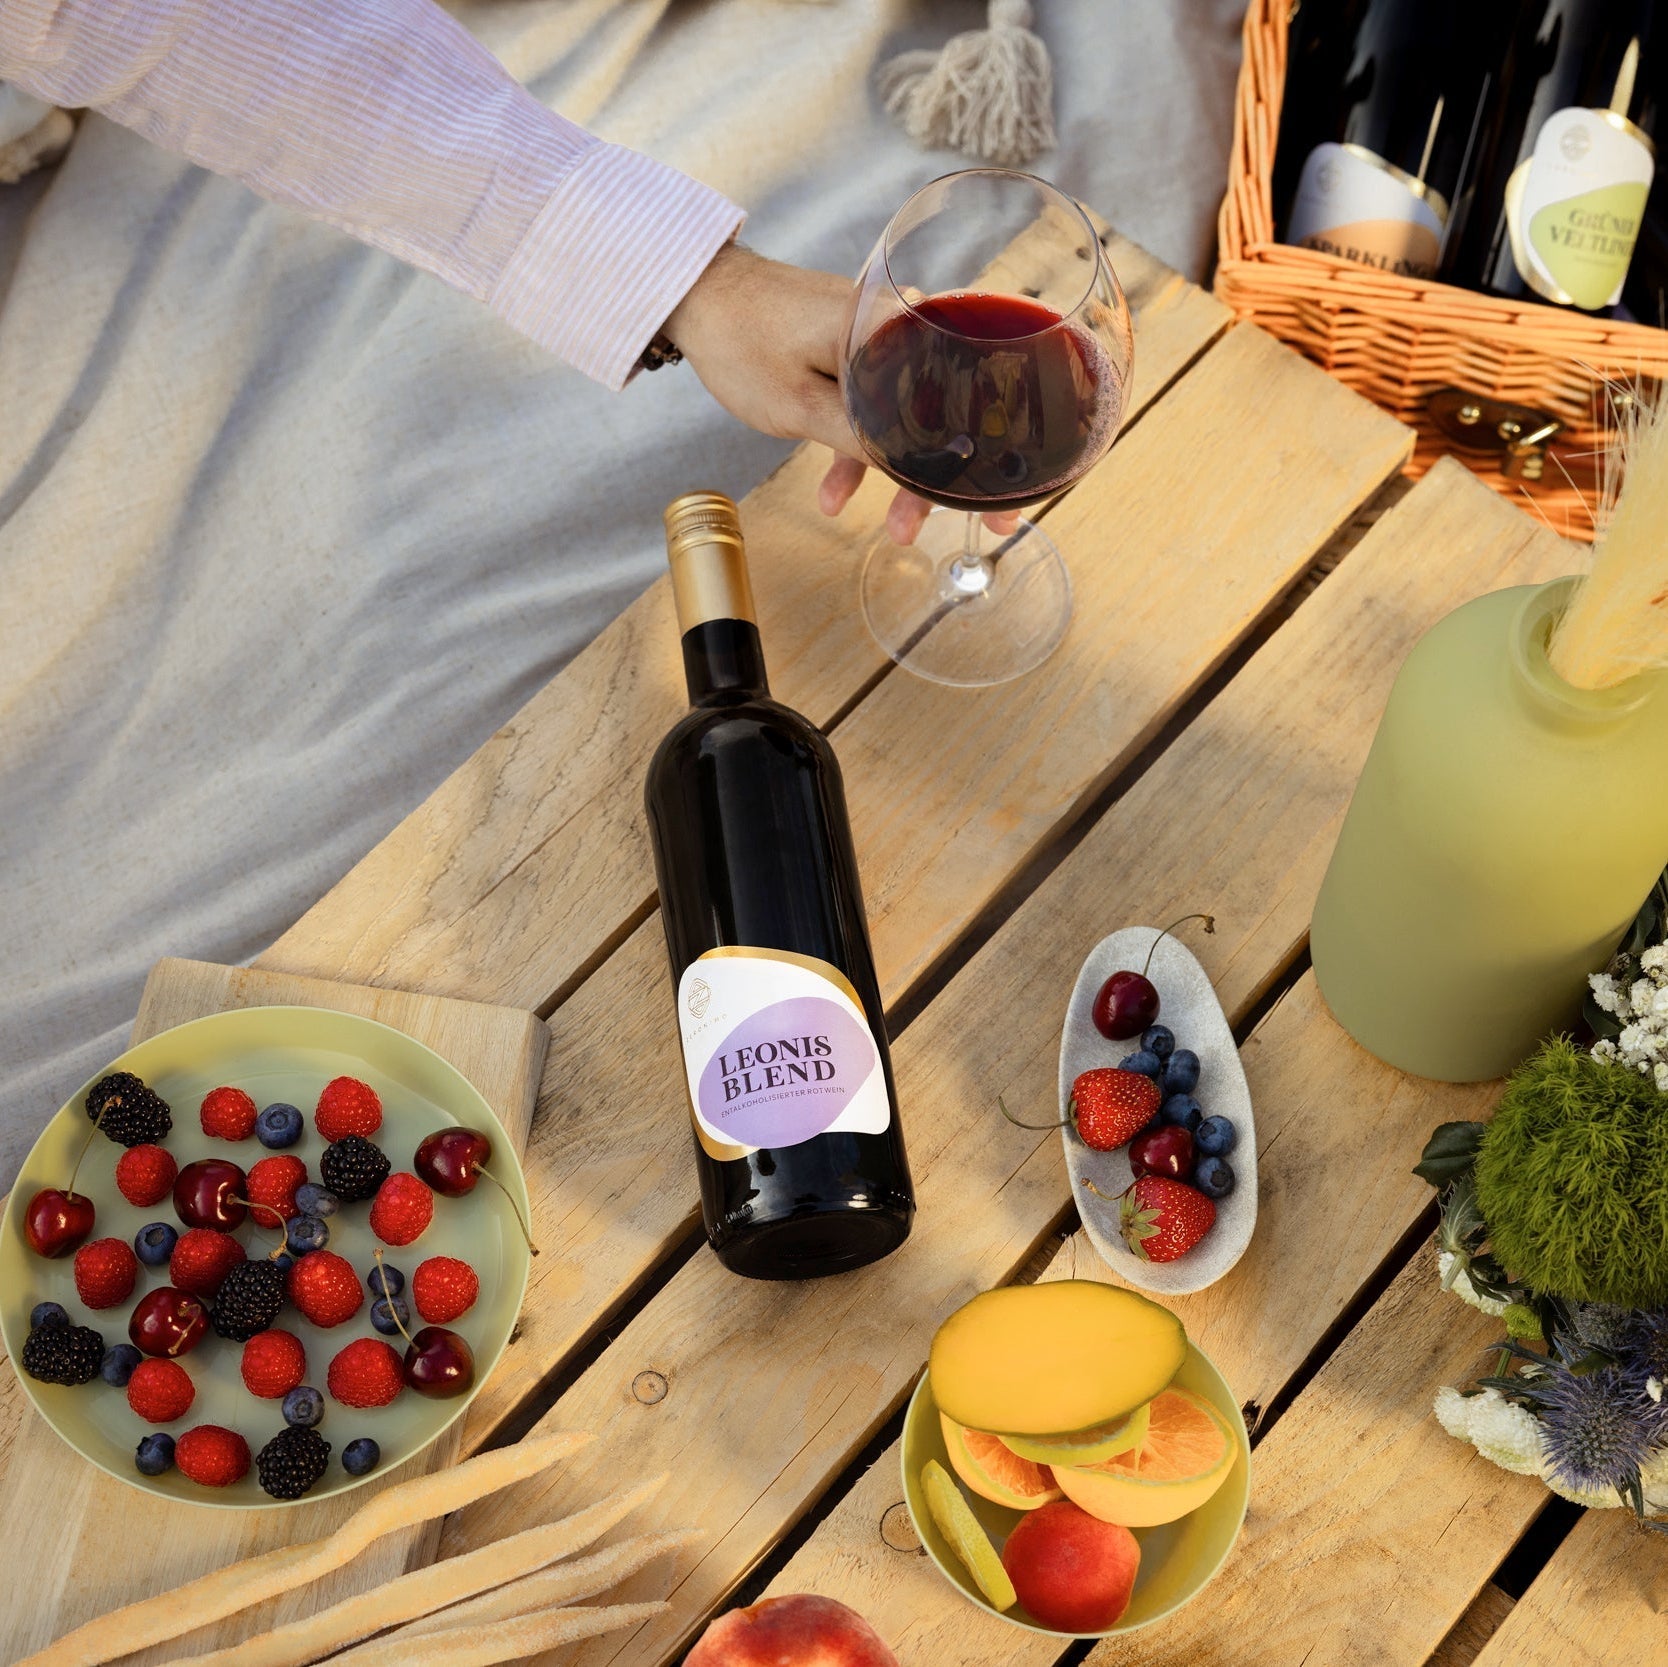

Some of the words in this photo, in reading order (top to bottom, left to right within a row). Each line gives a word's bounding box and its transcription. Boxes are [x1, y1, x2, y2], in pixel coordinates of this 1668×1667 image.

[1568, 208, 1635, 236] GRÜNE
[718, 1035, 832, 1078] LEONIS
[723, 1060, 836, 1103] BLEND
[721, 1089, 806, 1118] ENTALKOHOLISIERTER
[807, 1087, 845, 1095] ROTWEIN
